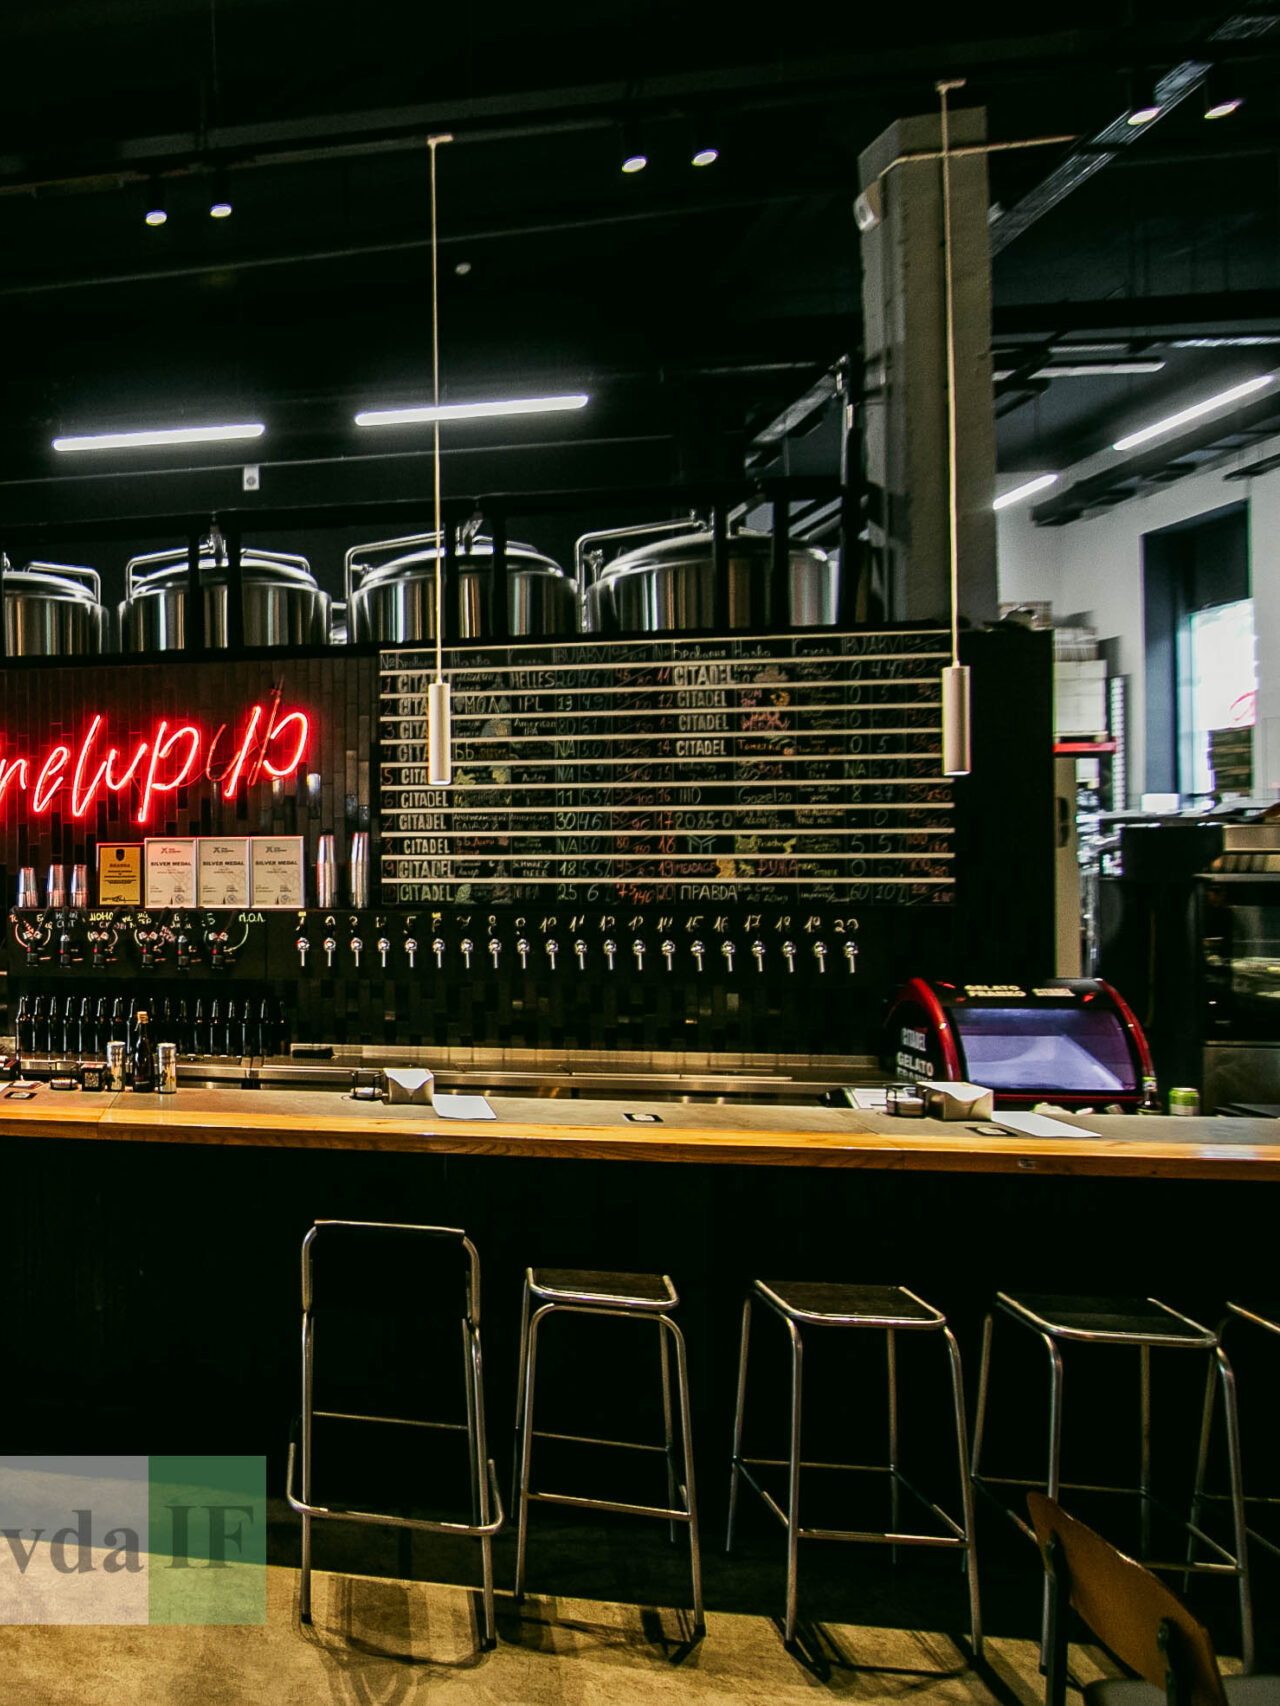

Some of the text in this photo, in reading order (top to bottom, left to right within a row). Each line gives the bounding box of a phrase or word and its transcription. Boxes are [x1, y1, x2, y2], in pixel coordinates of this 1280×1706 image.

[509, 670, 556, 689] HELLES
[673, 664, 736, 685] CITADEL
[518, 695, 544, 712] IPL
[676, 690, 728, 708] CITADEL
[678, 713, 730, 731] CITADEL
[676, 739, 727, 756] CITADEL
[384, 768, 394, 785] 5
[401, 790, 449, 808] CITADEL
[399, 813, 447, 831] CITADEL
[556, 811, 576, 830] 30
[403, 838, 451, 854] CITADEL
[398, 860, 456, 878] CITADEL
[559, 860, 577, 877] 18
[400, 883, 455, 901] CITADEL
[557, 882, 578, 901] 25
[897, 1050, 935, 1077] GELATO
